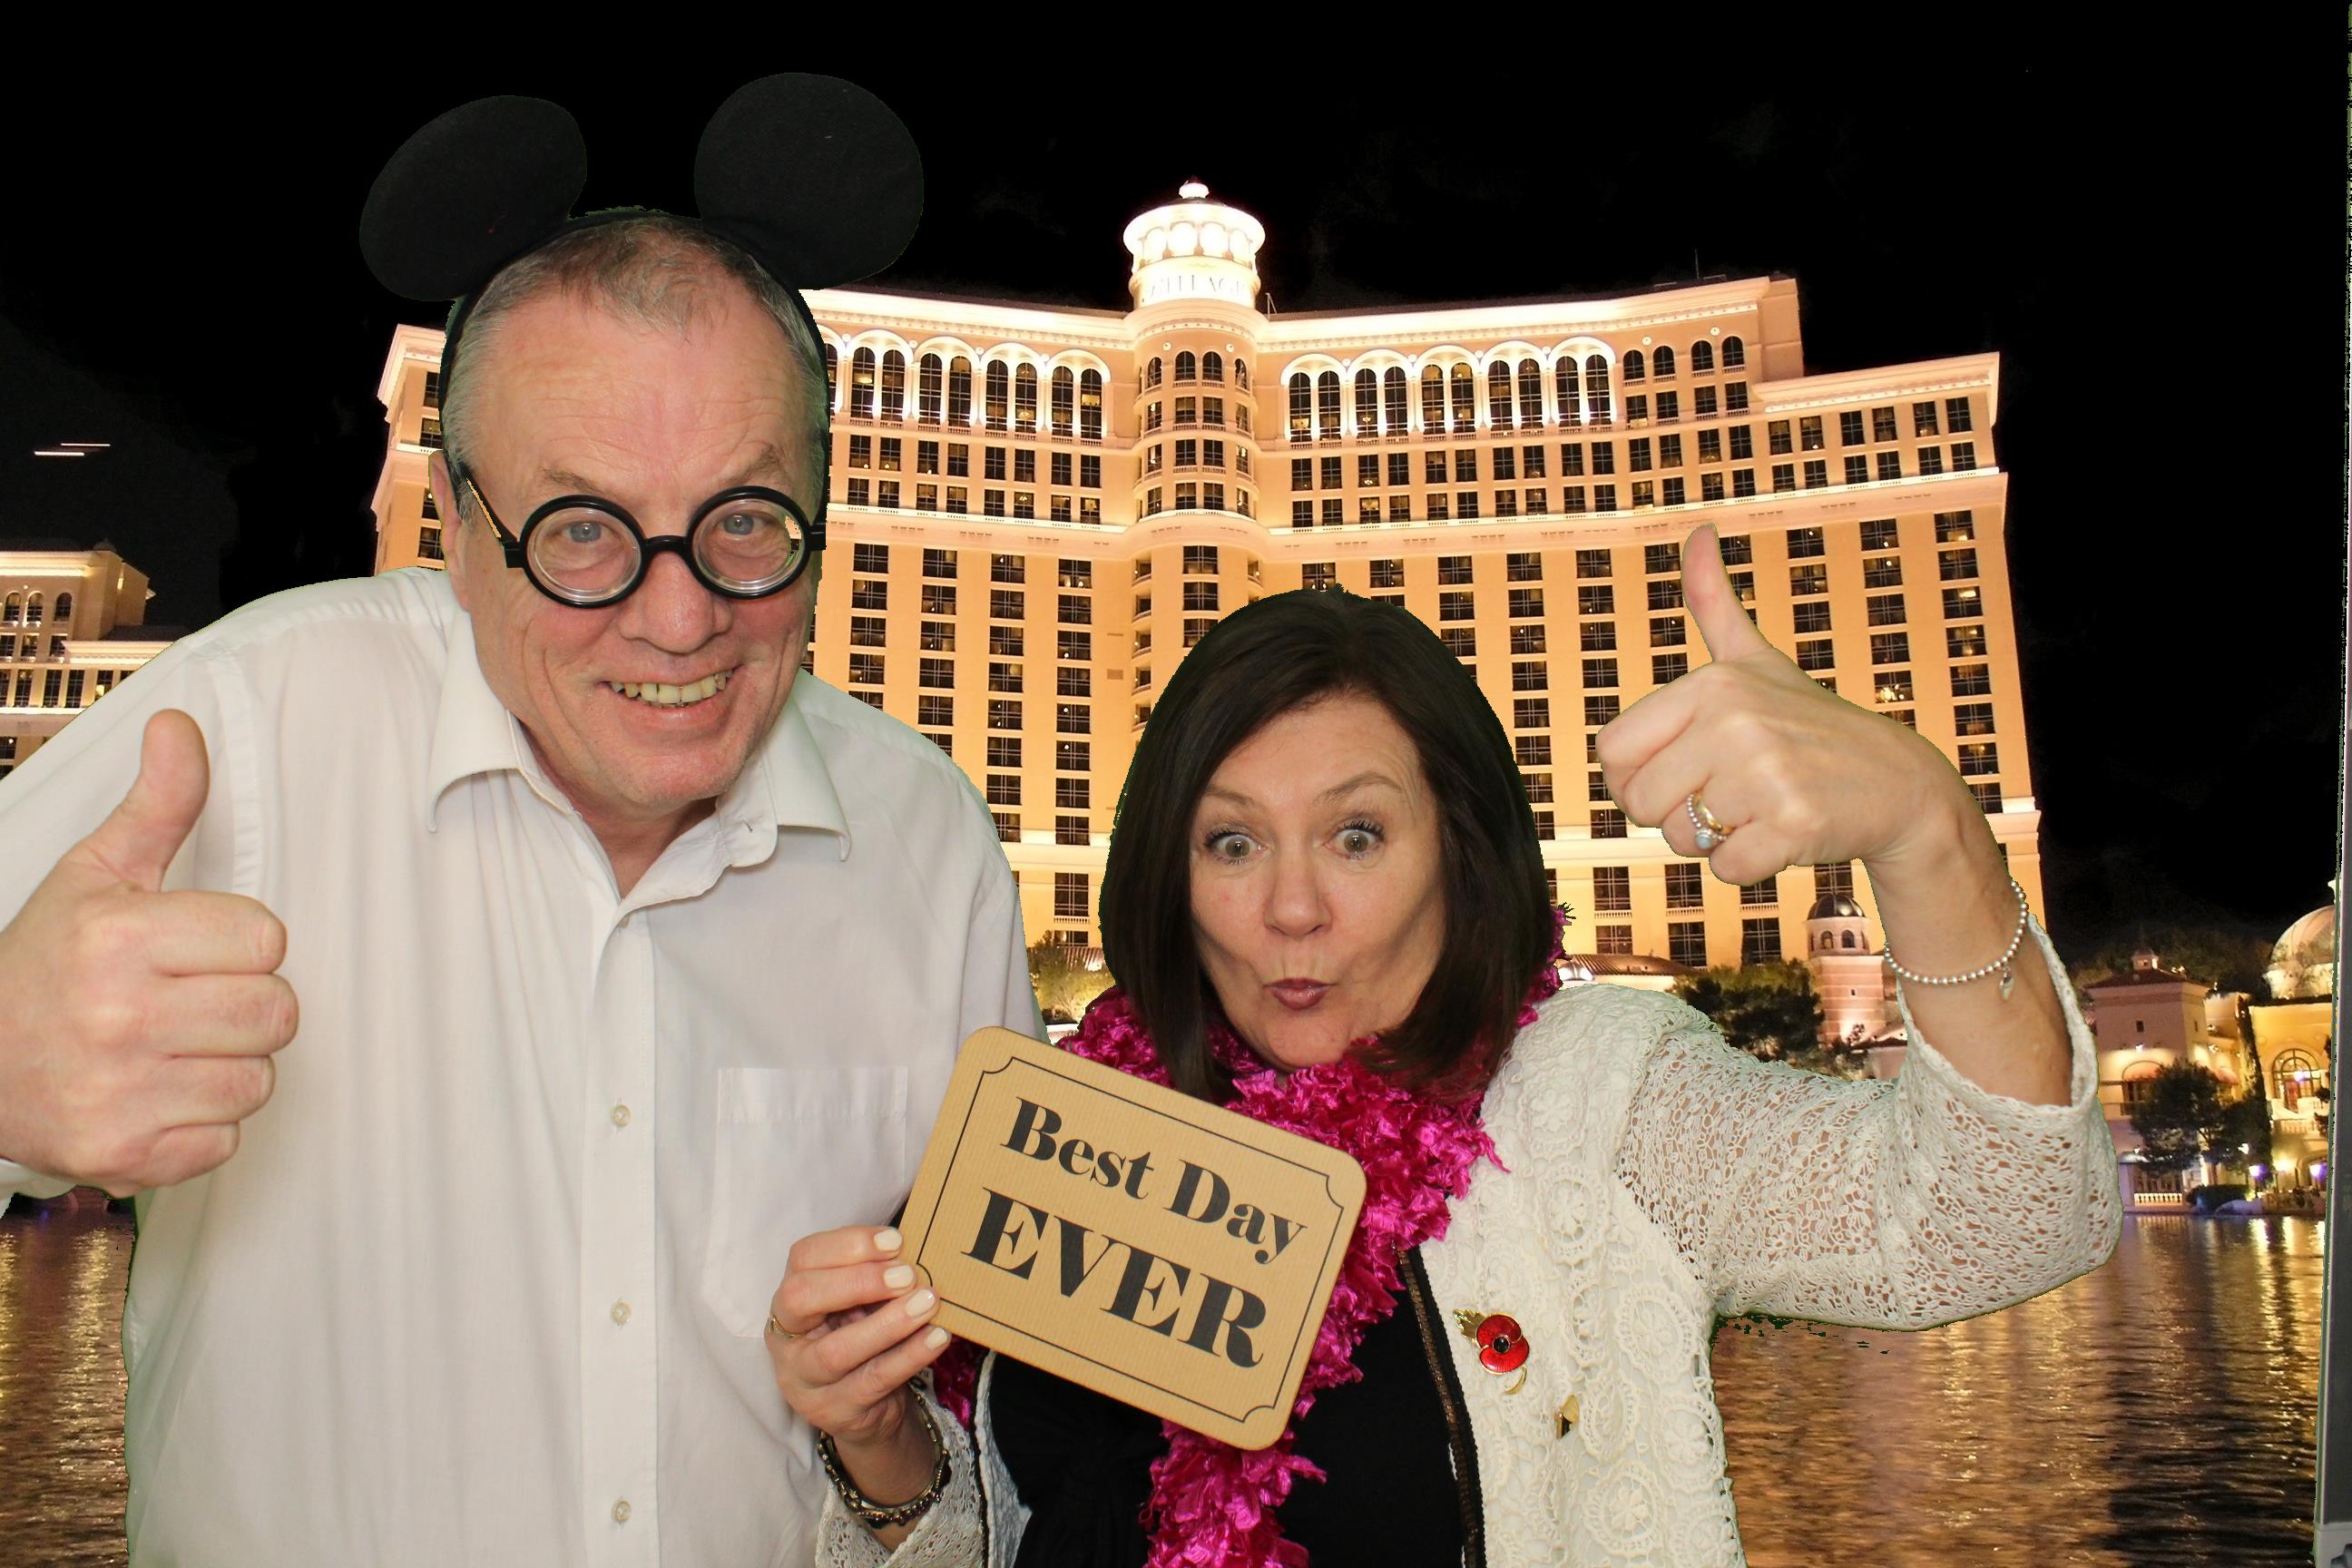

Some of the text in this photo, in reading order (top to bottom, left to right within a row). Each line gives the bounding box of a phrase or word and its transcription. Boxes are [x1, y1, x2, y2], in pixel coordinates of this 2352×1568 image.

[1000, 1096, 1308, 1265] Best Day
[961, 1187, 1267, 1367] EVER
